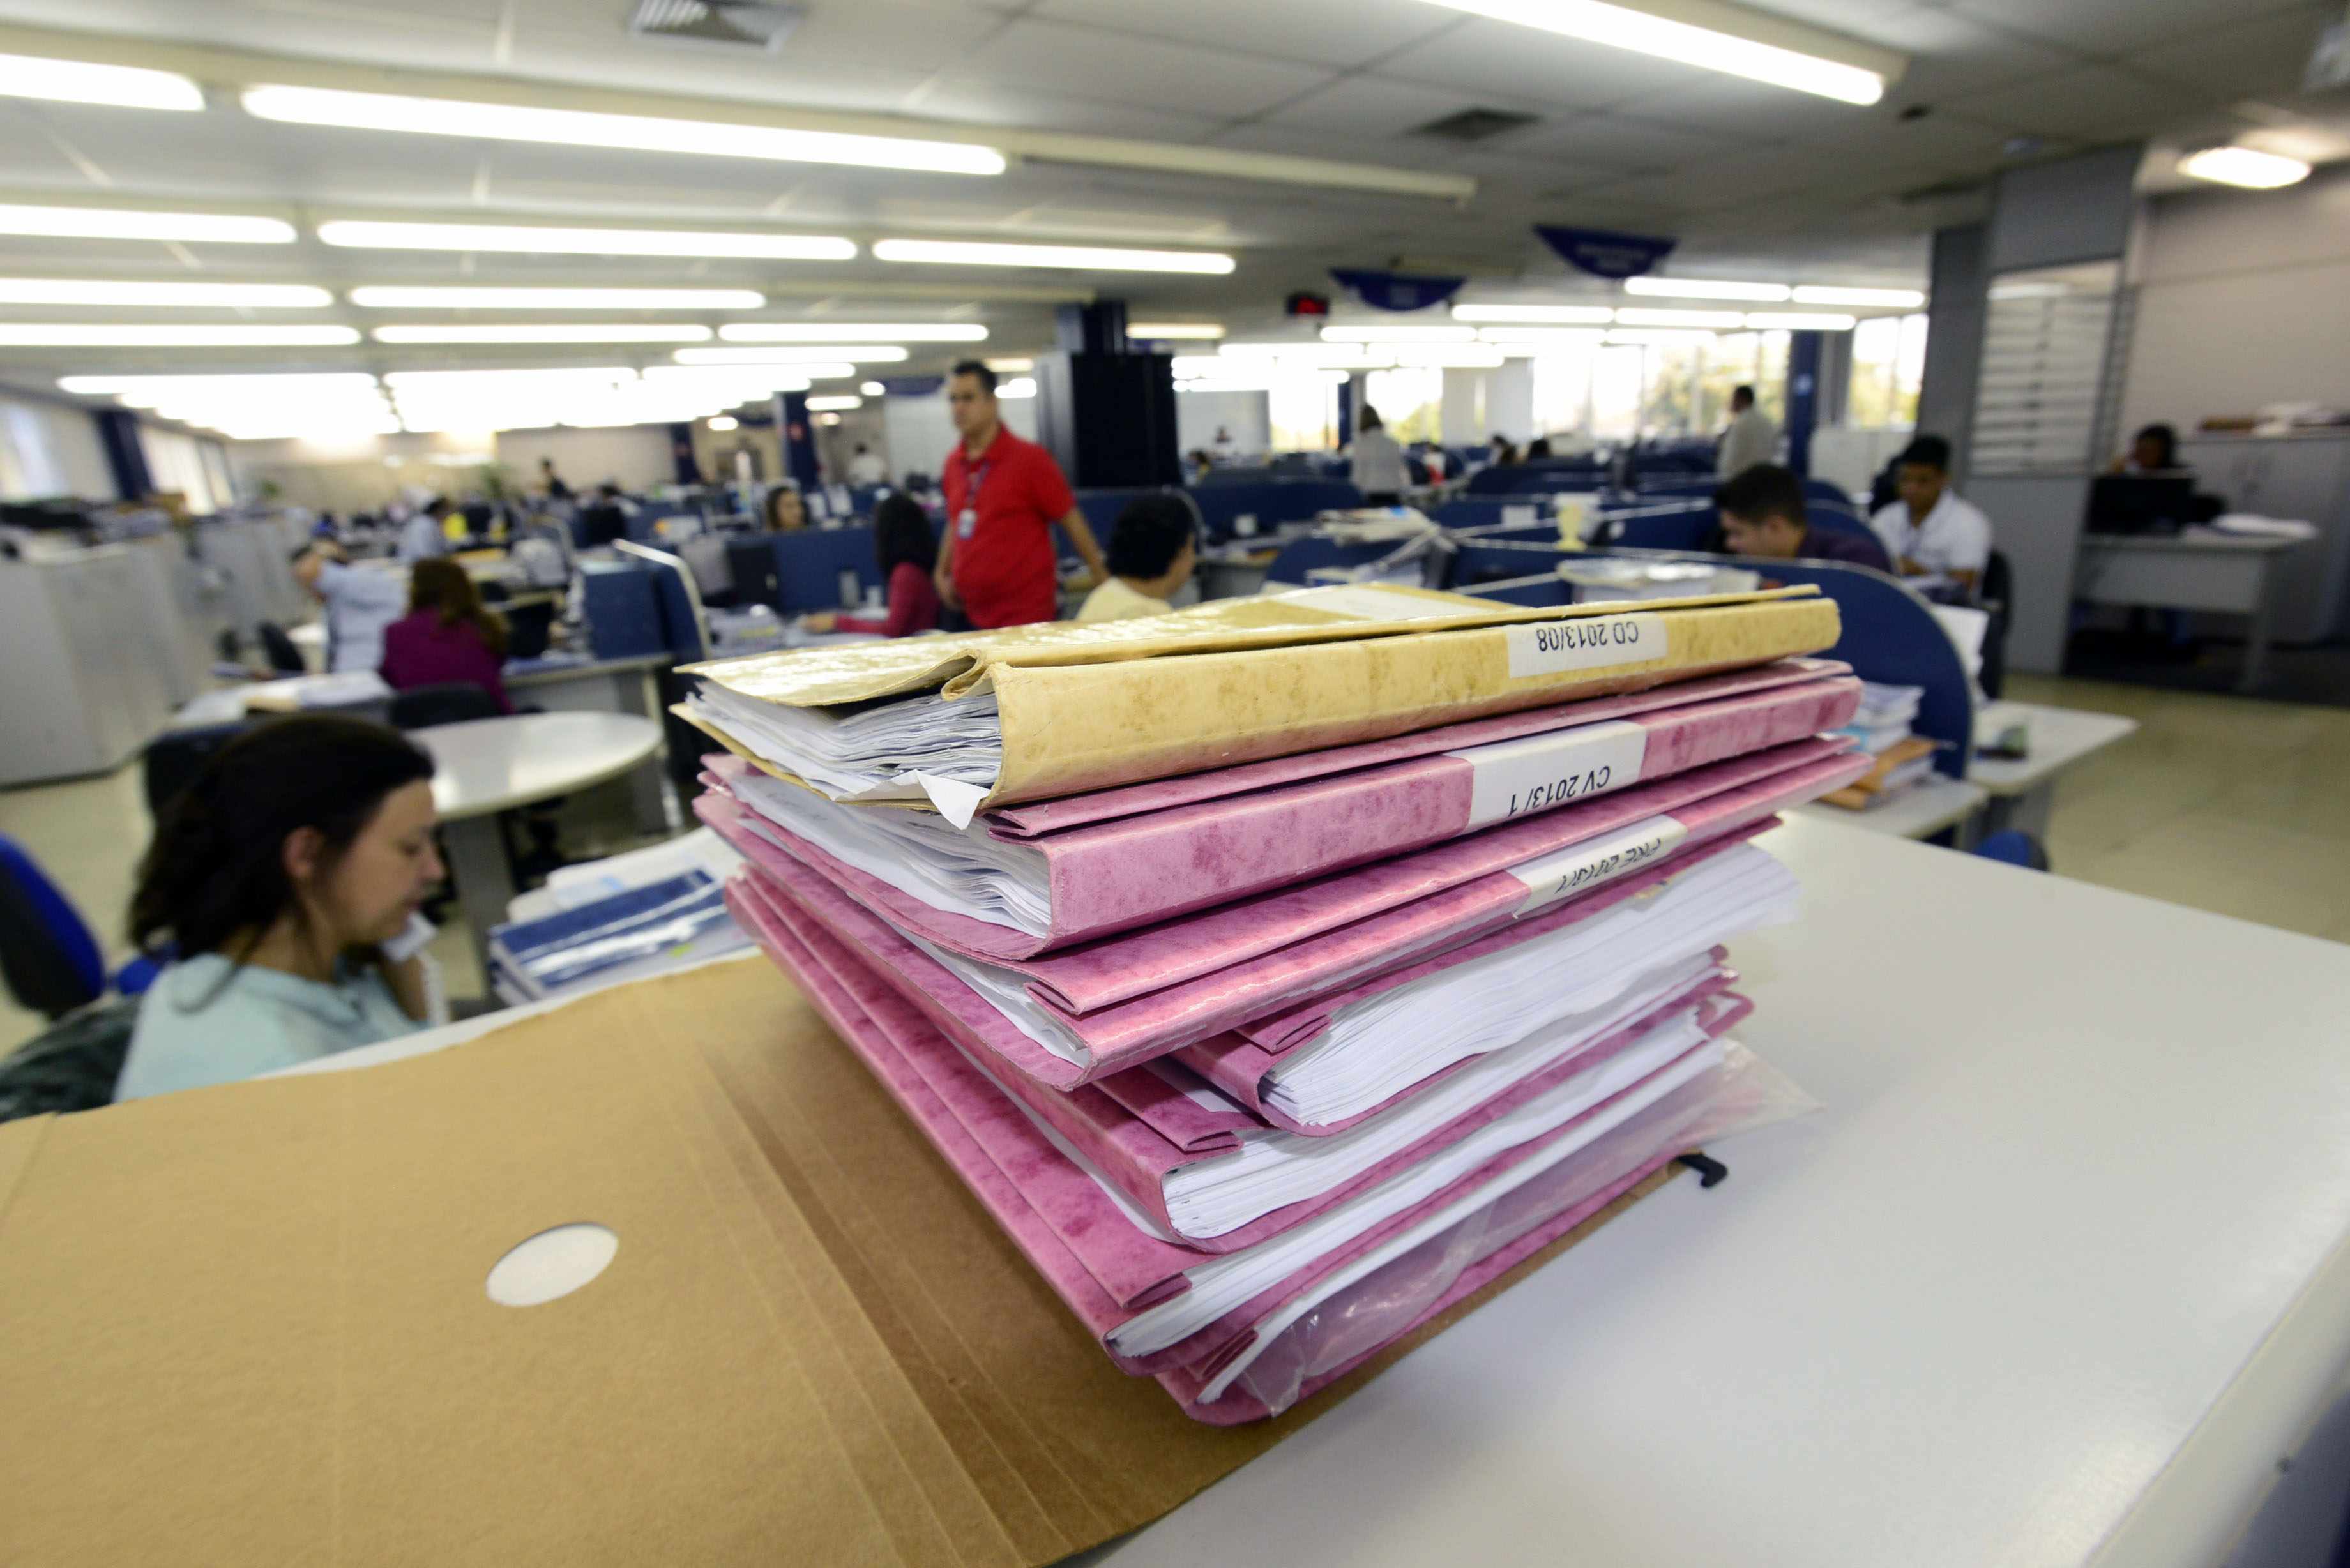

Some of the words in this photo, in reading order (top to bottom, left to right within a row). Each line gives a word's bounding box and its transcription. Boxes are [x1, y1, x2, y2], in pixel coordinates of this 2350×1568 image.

[1536, 623, 1608, 652] 2013/08
[1612, 621, 1639, 645] CD
[1582, 765, 1611, 794] CV
